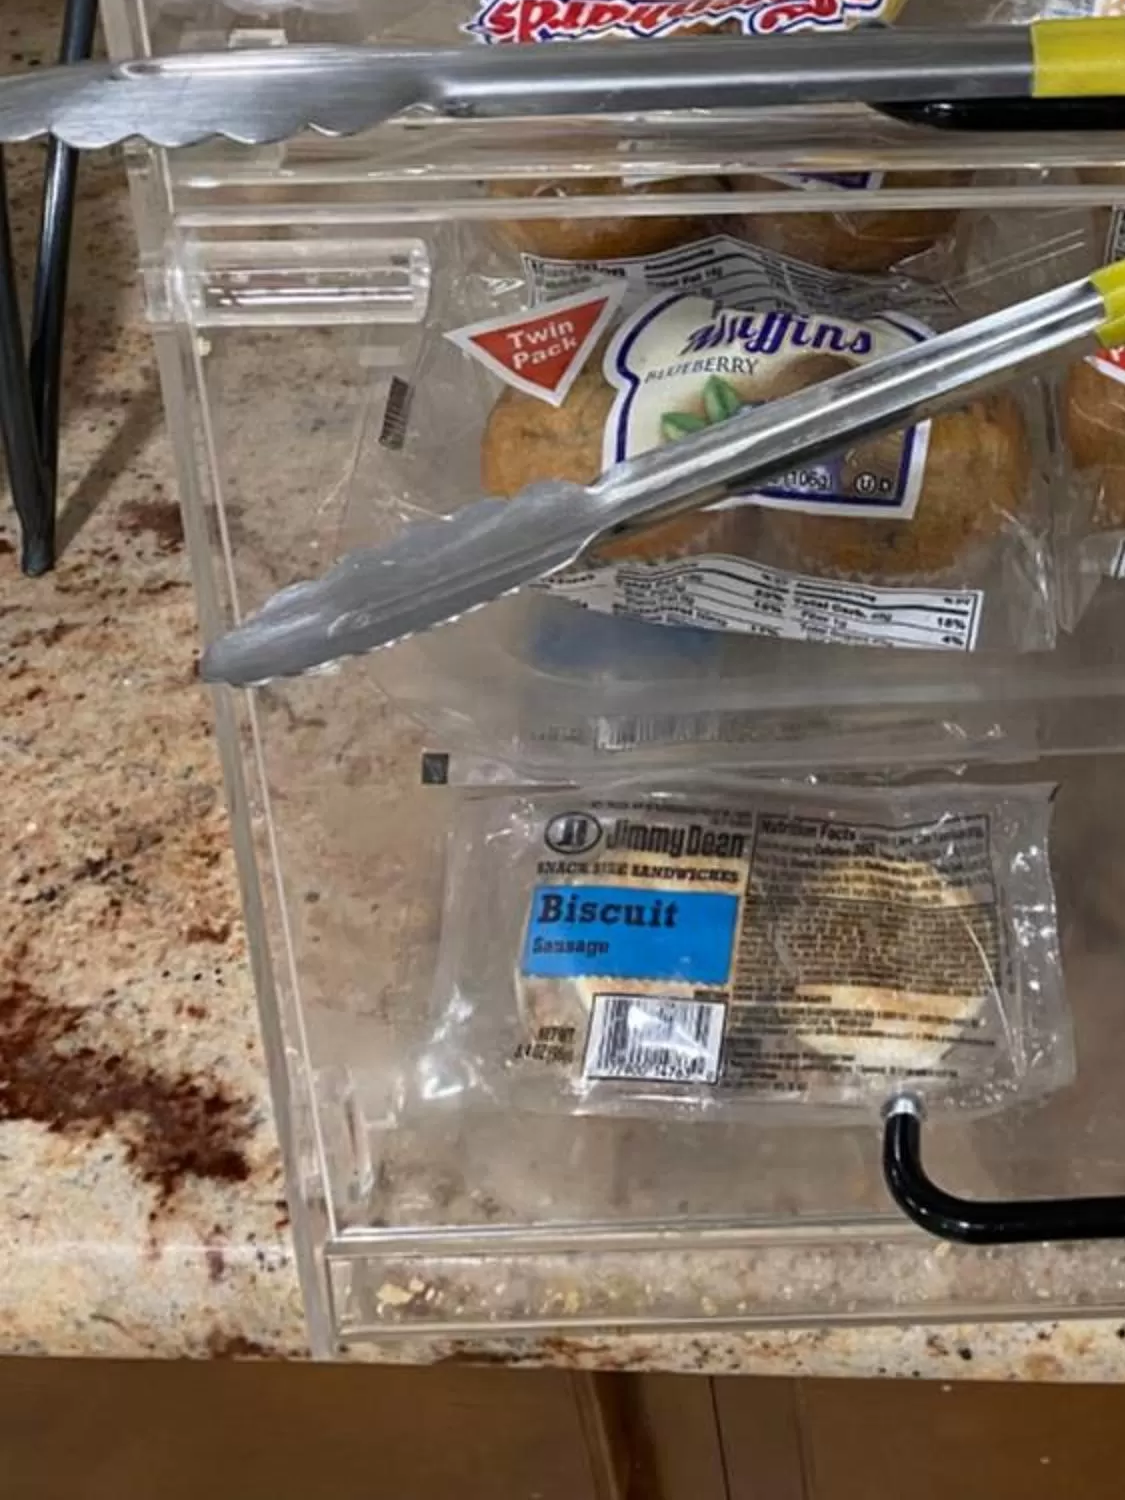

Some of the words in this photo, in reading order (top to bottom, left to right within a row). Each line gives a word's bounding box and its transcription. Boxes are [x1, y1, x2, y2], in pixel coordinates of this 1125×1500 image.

[506, 316, 575, 351] Twin
[512, 336, 579, 371] Pack
[606, 818, 686, 858] Jimmy
[686, 824, 746, 859] Dean
[538, 893, 680, 931] Biscuit
[532, 935, 612, 959] Sausage
